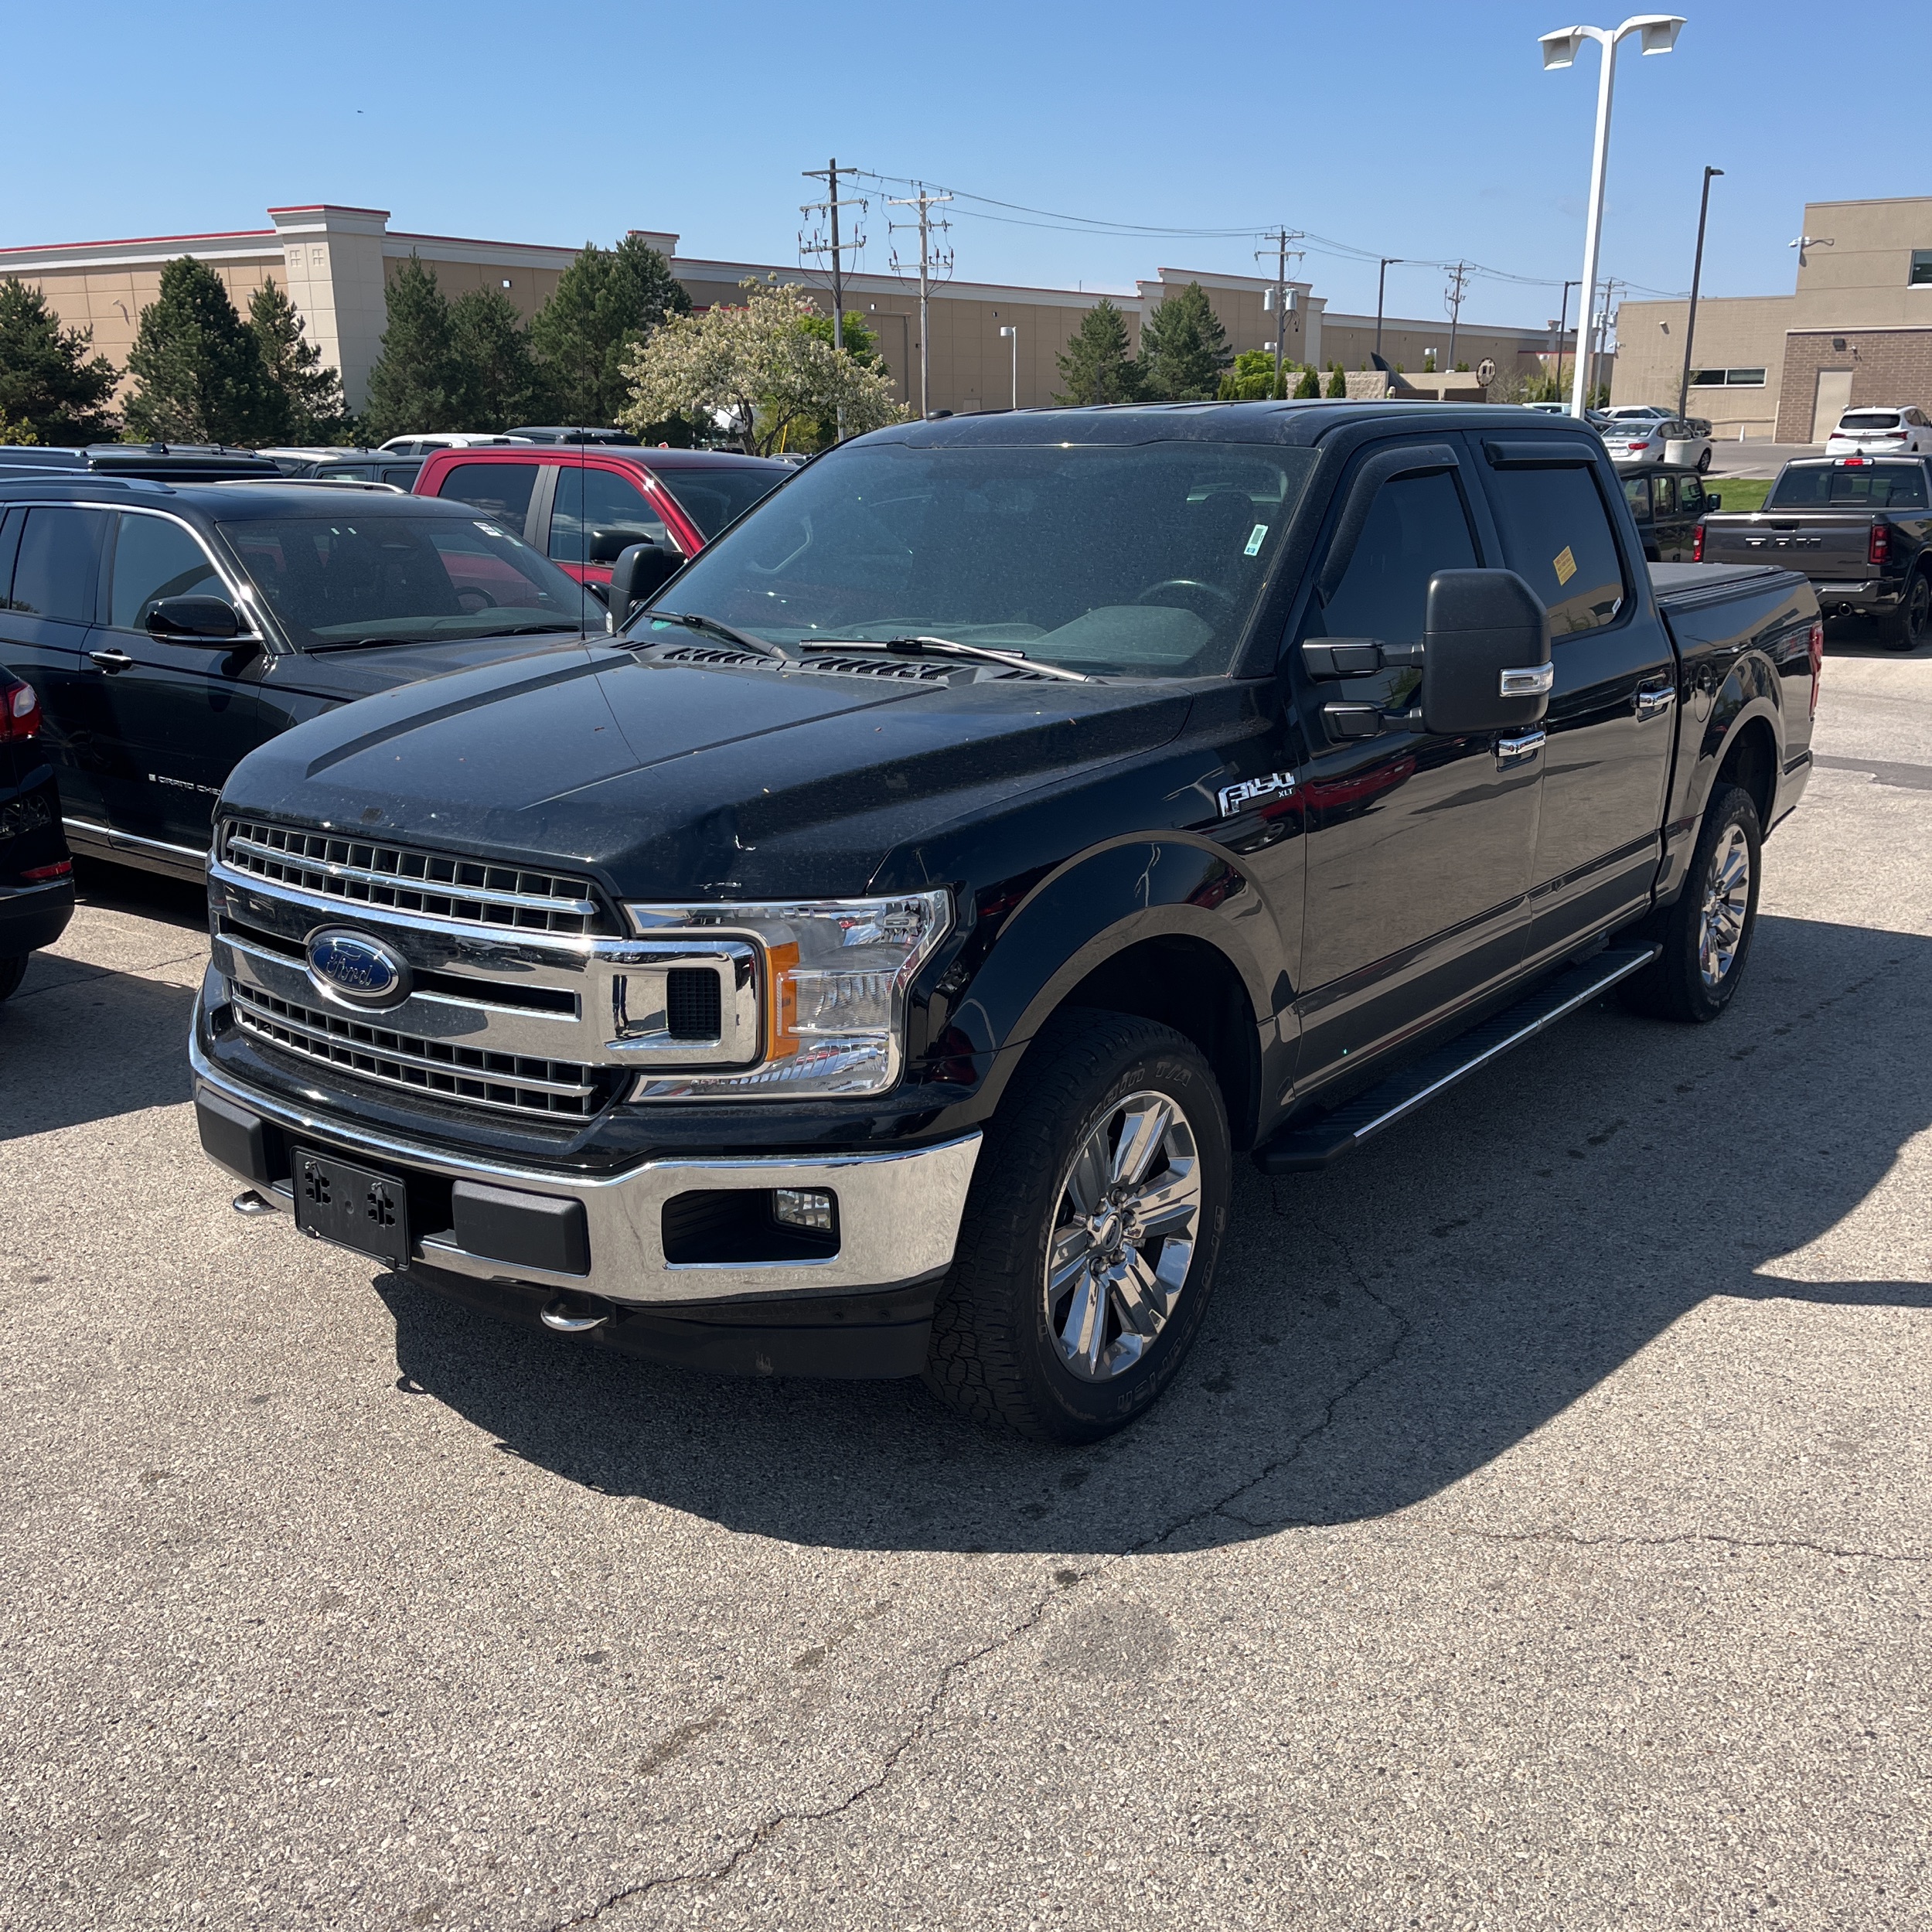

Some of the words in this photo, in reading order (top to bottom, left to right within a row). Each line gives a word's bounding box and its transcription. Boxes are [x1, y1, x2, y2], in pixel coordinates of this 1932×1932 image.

[1745, 537, 1821, 549] RAM
[158, 775, 195, 790] GRAND
[1278, 788, 1293, 798] XLT
[325, 948, 373, 986] Ford
[1155, 1061, 1192, 1087] T/A
